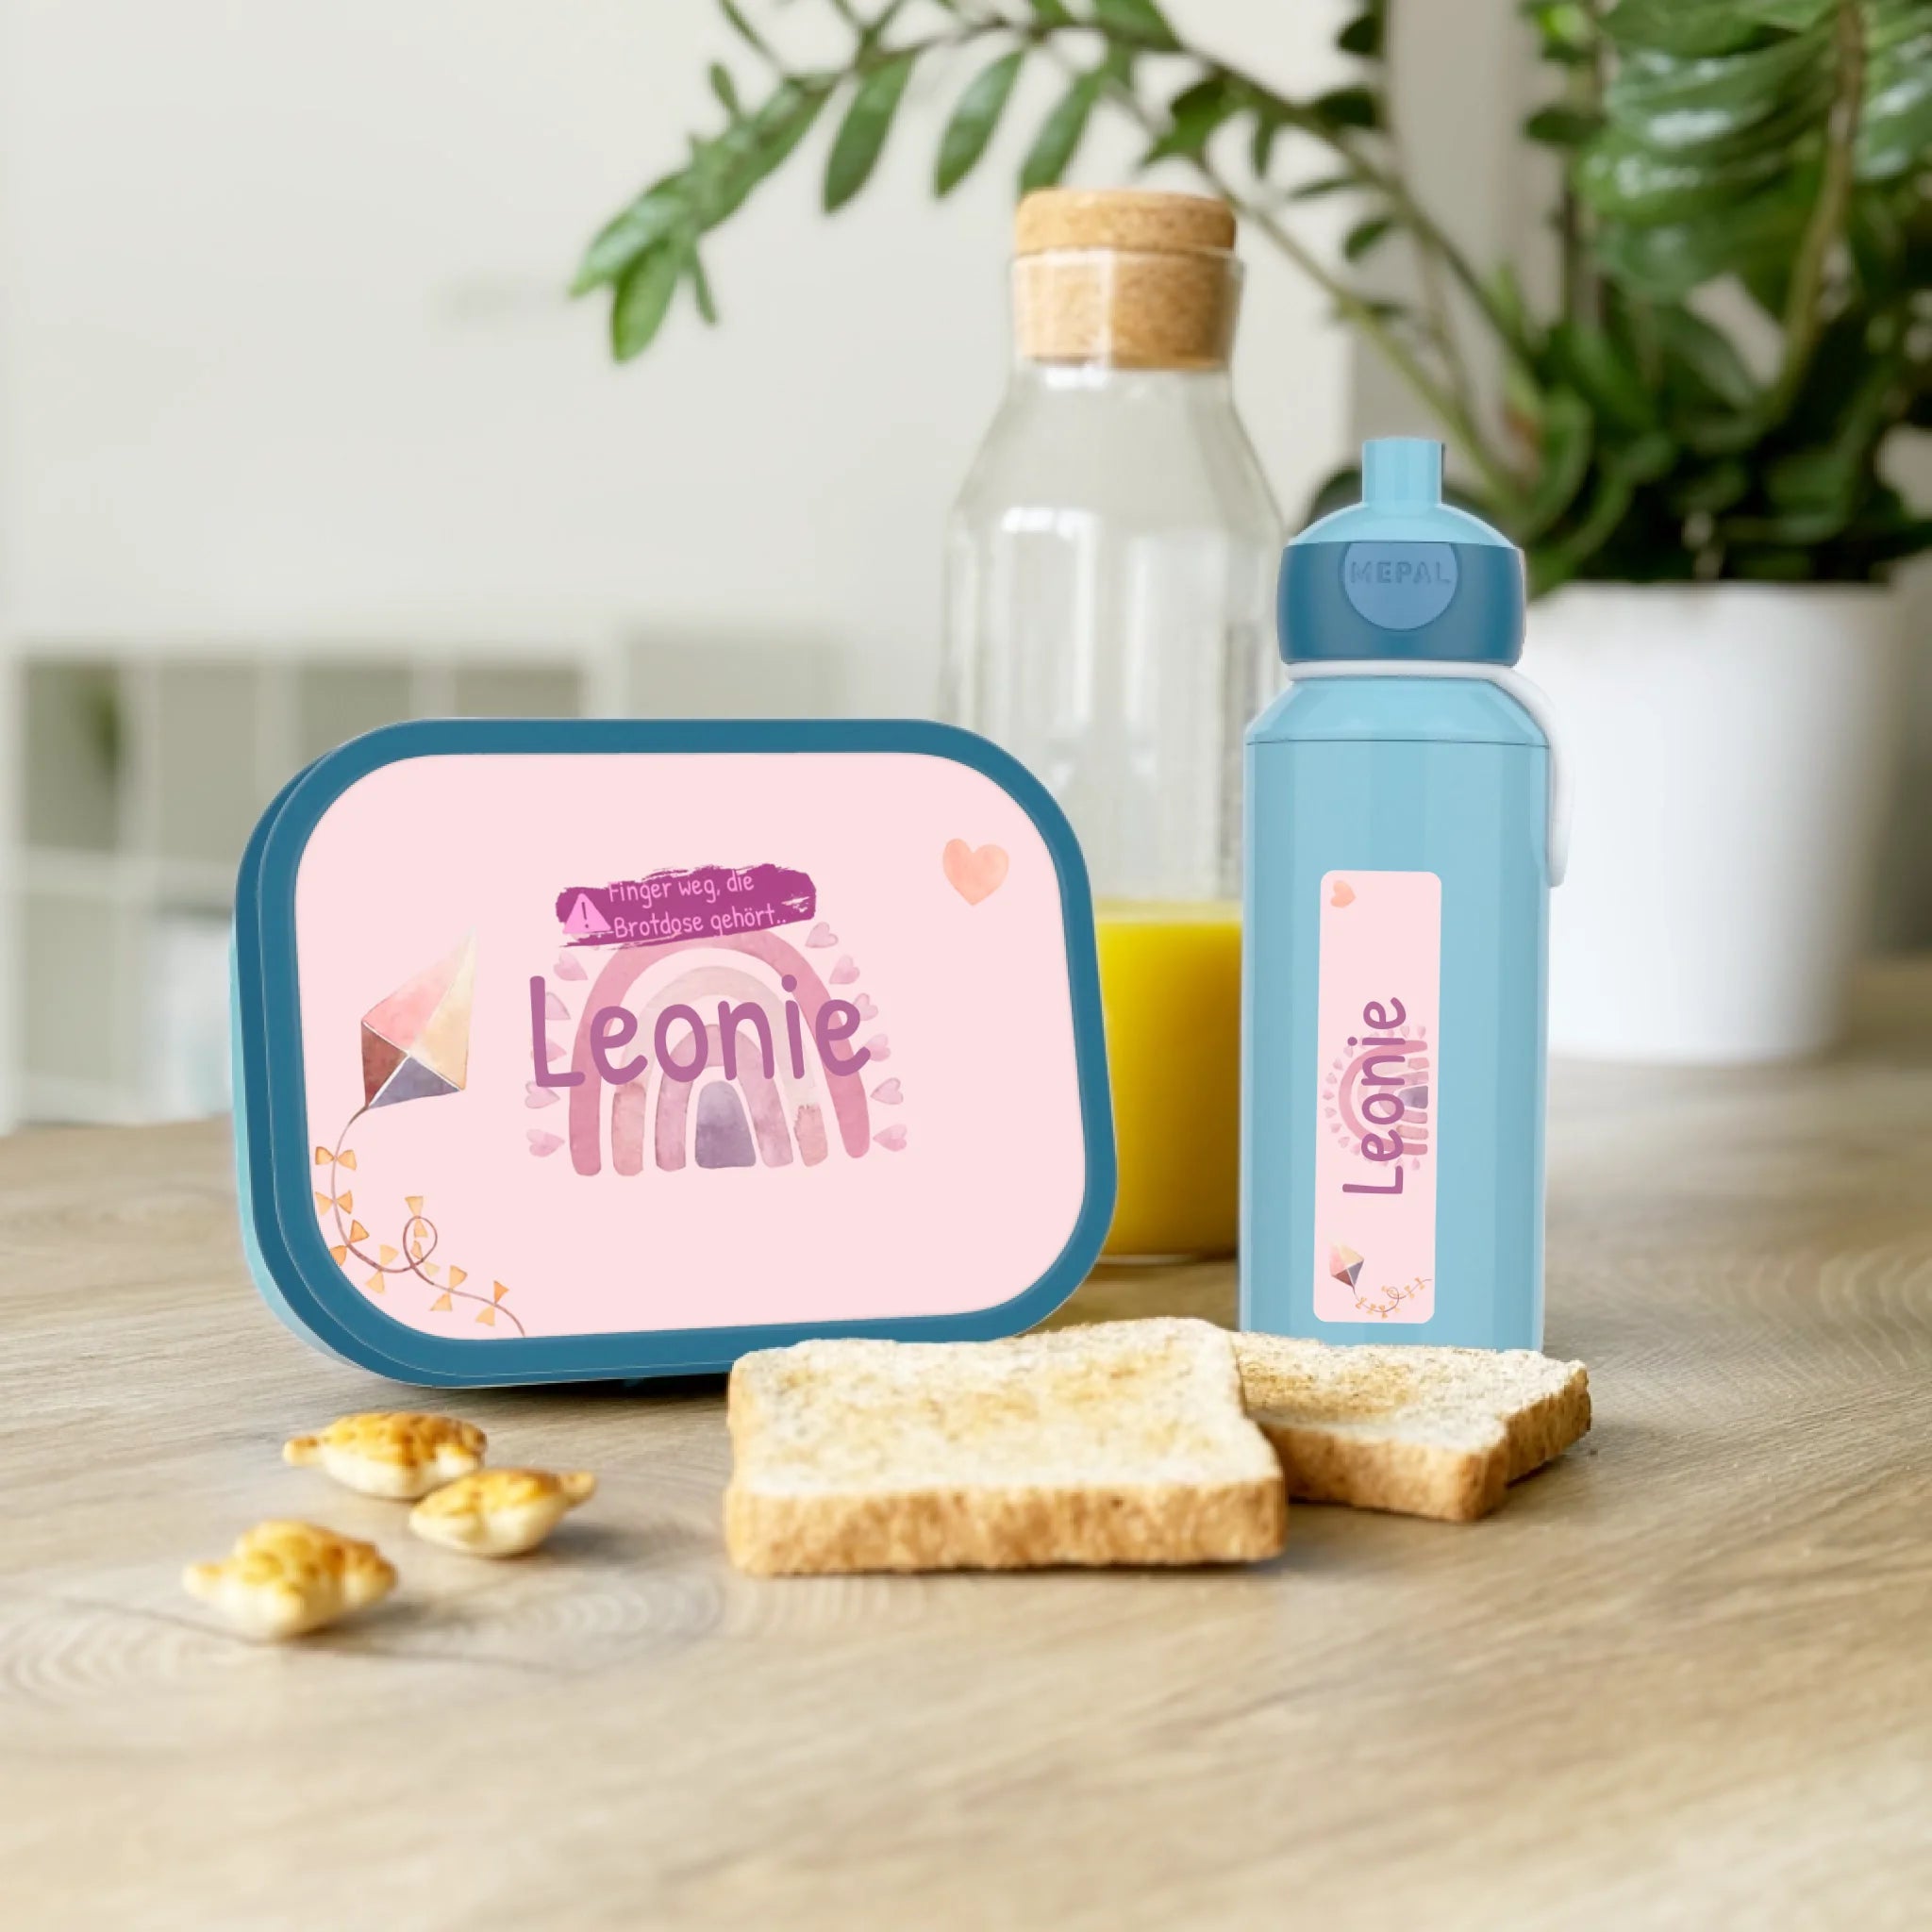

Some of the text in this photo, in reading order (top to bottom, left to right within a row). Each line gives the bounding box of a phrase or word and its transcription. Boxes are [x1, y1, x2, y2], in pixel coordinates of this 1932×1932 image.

[1350, 560, 1451, 584] MEPAL
[608, 869, 755, 908] Finger weg, die
[613, 911, 704, 938] Brotdose
[530, 974, 871, 1087] Leonie
[1341, 997, 1407, 1194] Leonie
